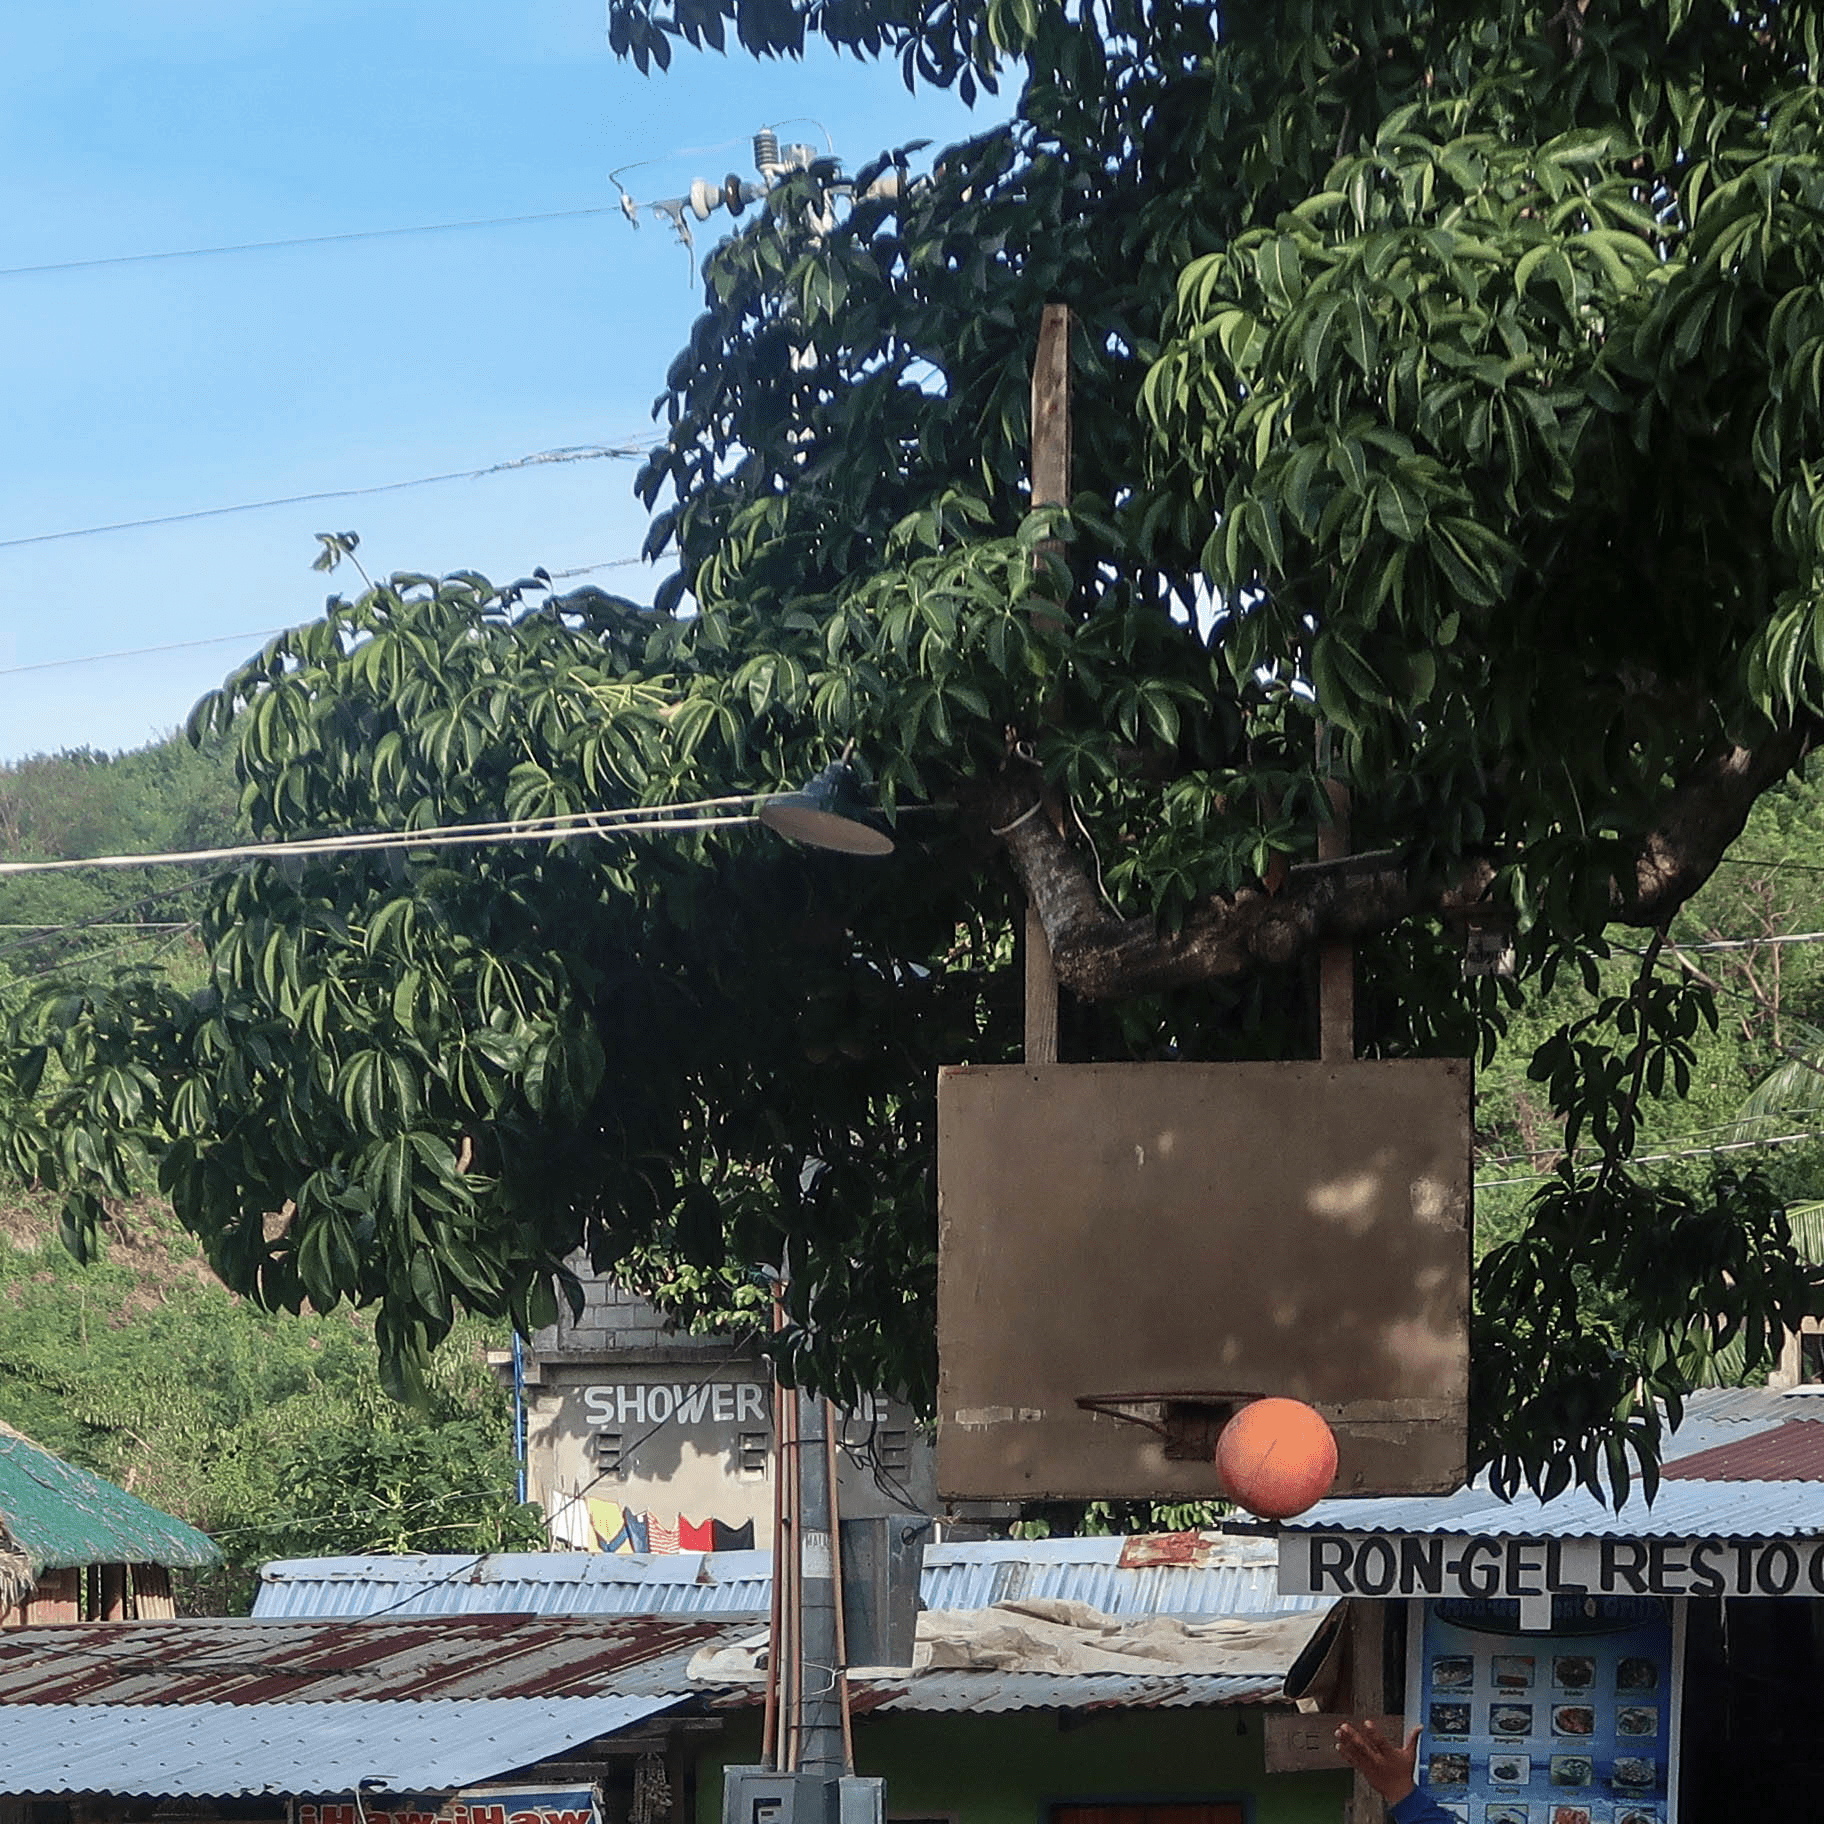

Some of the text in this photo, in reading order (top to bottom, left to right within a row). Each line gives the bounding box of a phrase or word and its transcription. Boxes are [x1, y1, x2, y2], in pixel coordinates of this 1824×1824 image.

[583, 1383, 766, 1425] SHOWER
[1308, 1535, 1588, 1598] RON-GEL
[1602, 1537, 1800, 1597] RESTO
